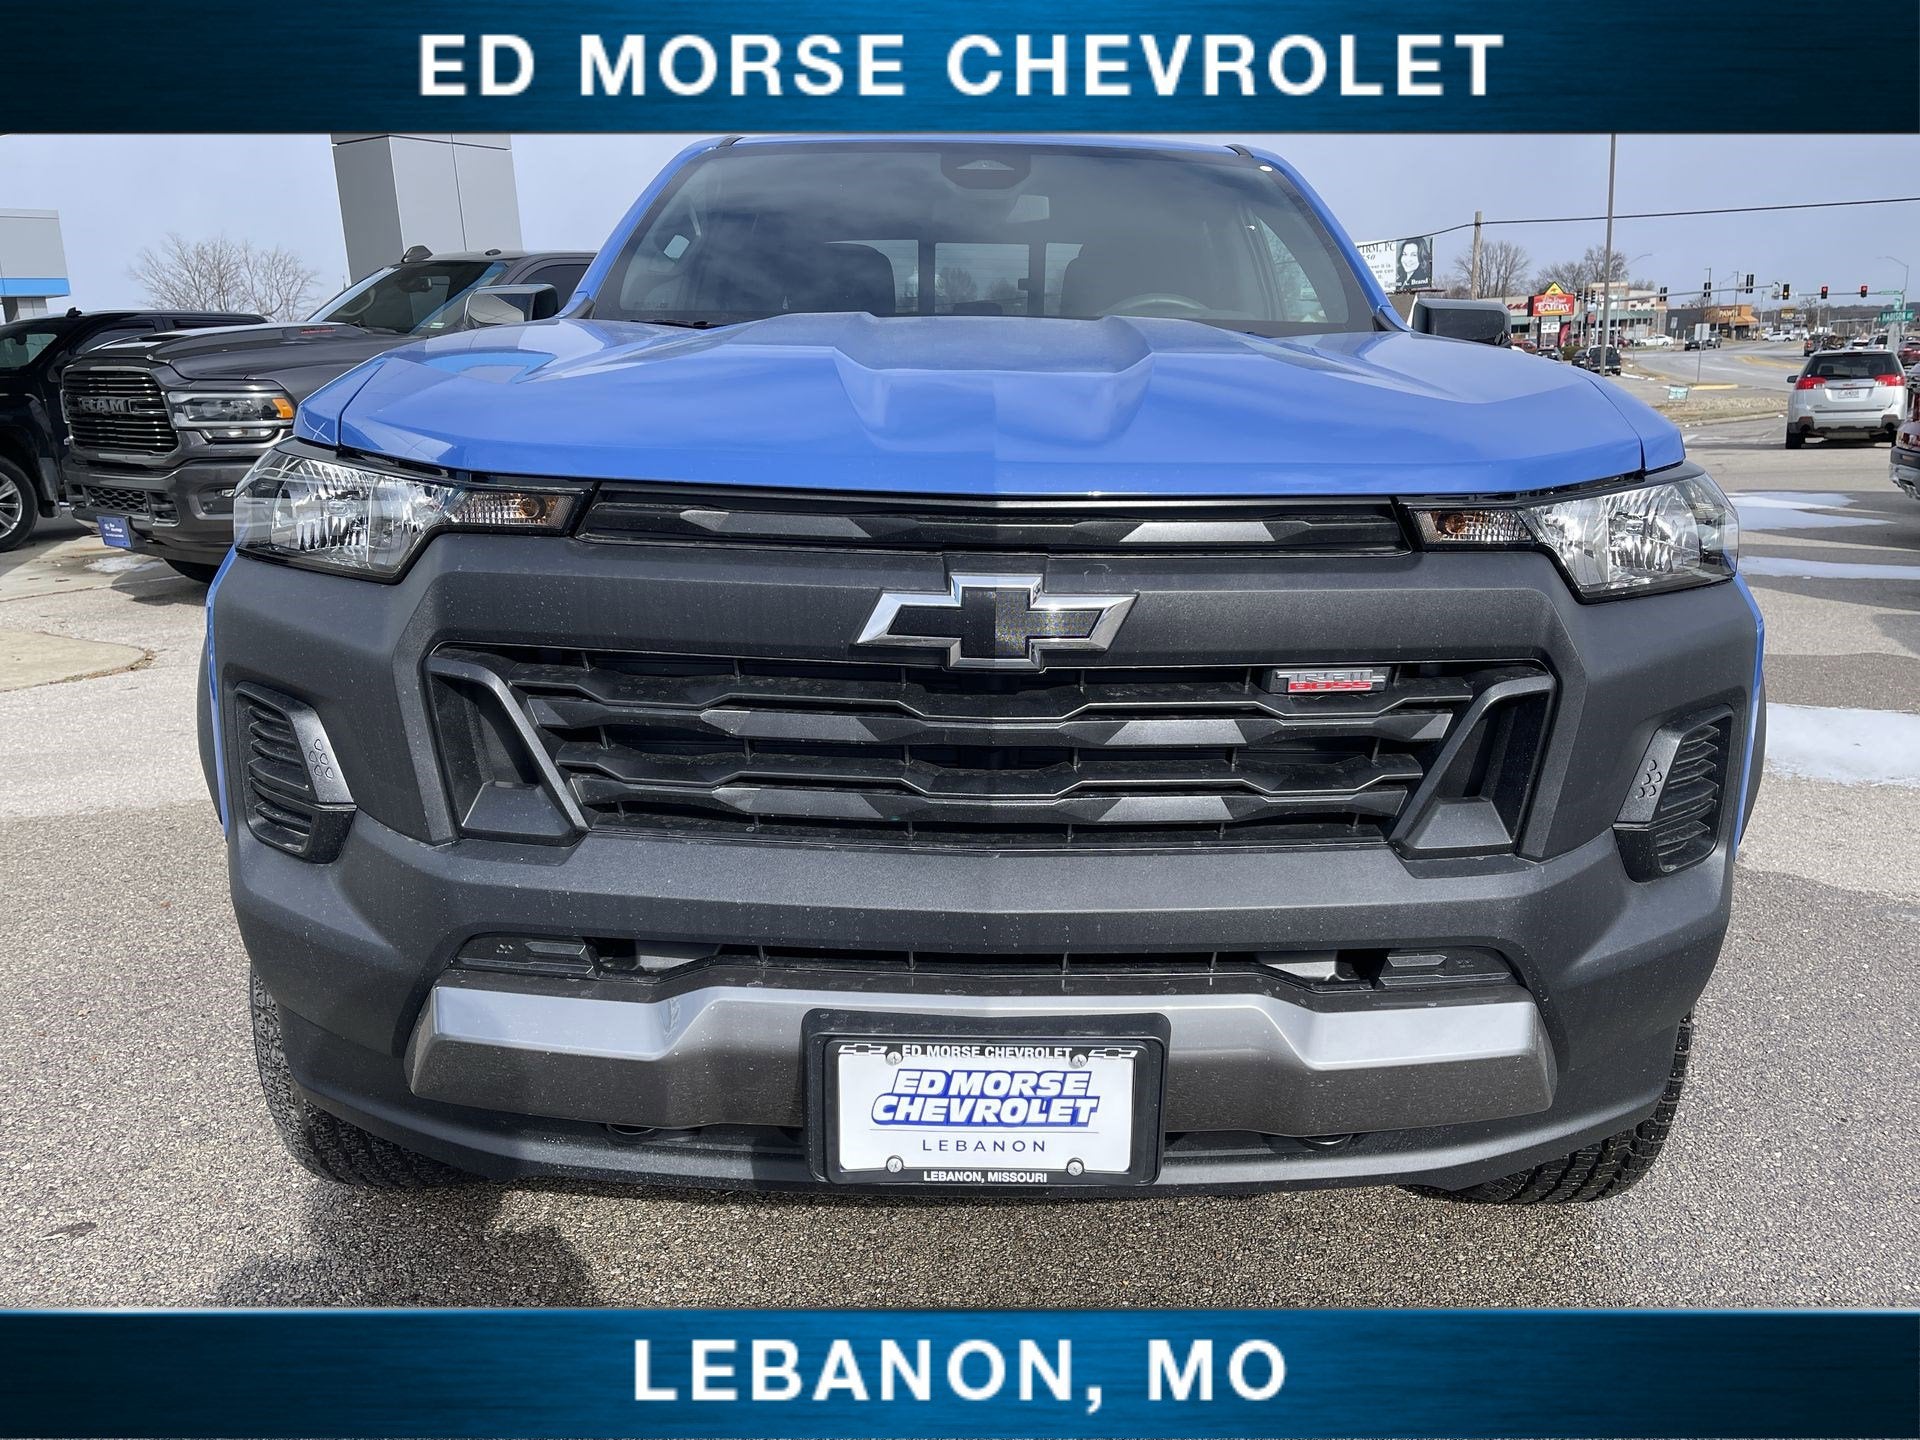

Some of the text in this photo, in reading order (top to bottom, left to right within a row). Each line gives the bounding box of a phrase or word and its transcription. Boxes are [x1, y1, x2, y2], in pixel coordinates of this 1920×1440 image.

[80, 398, 127, 413] RAM
[1287, 680, 1373, 693] BOSS
[901, 1044, 1073, 1060] ED MORSE CHEVROLET
[892, 1069, 1092, 1097] ED MORSE
[871, 1094, 1100, 1127] CHEVROLET
[922, 1139, 1046, 1153] LEBANON
[923, 1170, 1048, 1184] LEBANON, MISSOURI
